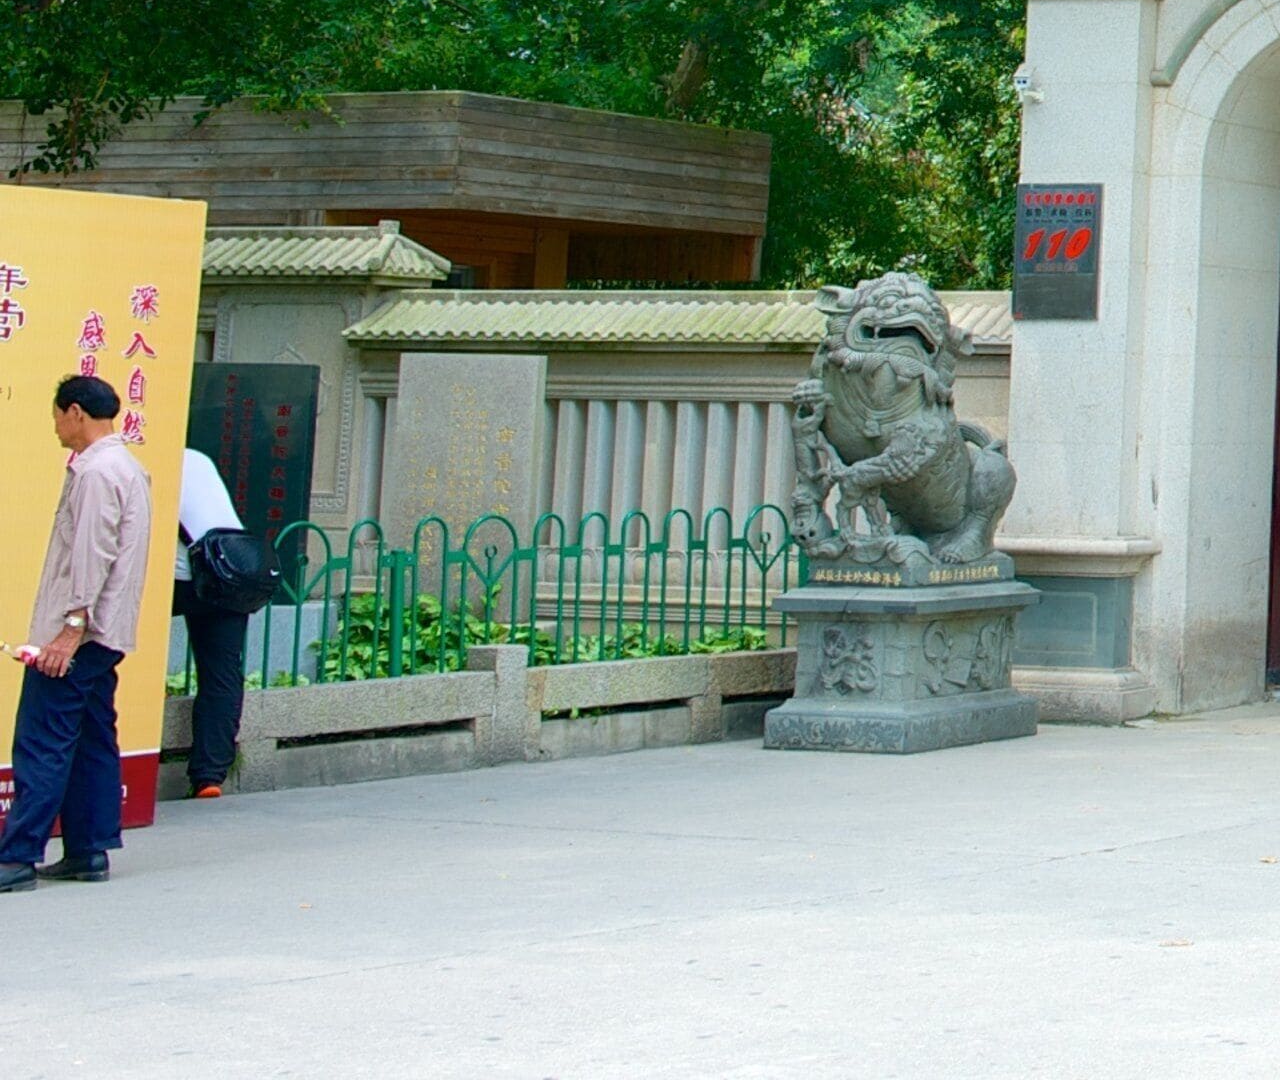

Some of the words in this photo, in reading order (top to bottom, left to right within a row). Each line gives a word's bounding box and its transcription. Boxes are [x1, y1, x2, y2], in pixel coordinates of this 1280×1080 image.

[1024, 228, 1093, 260] 110
[122, 285, 158, 442] 深入自然
